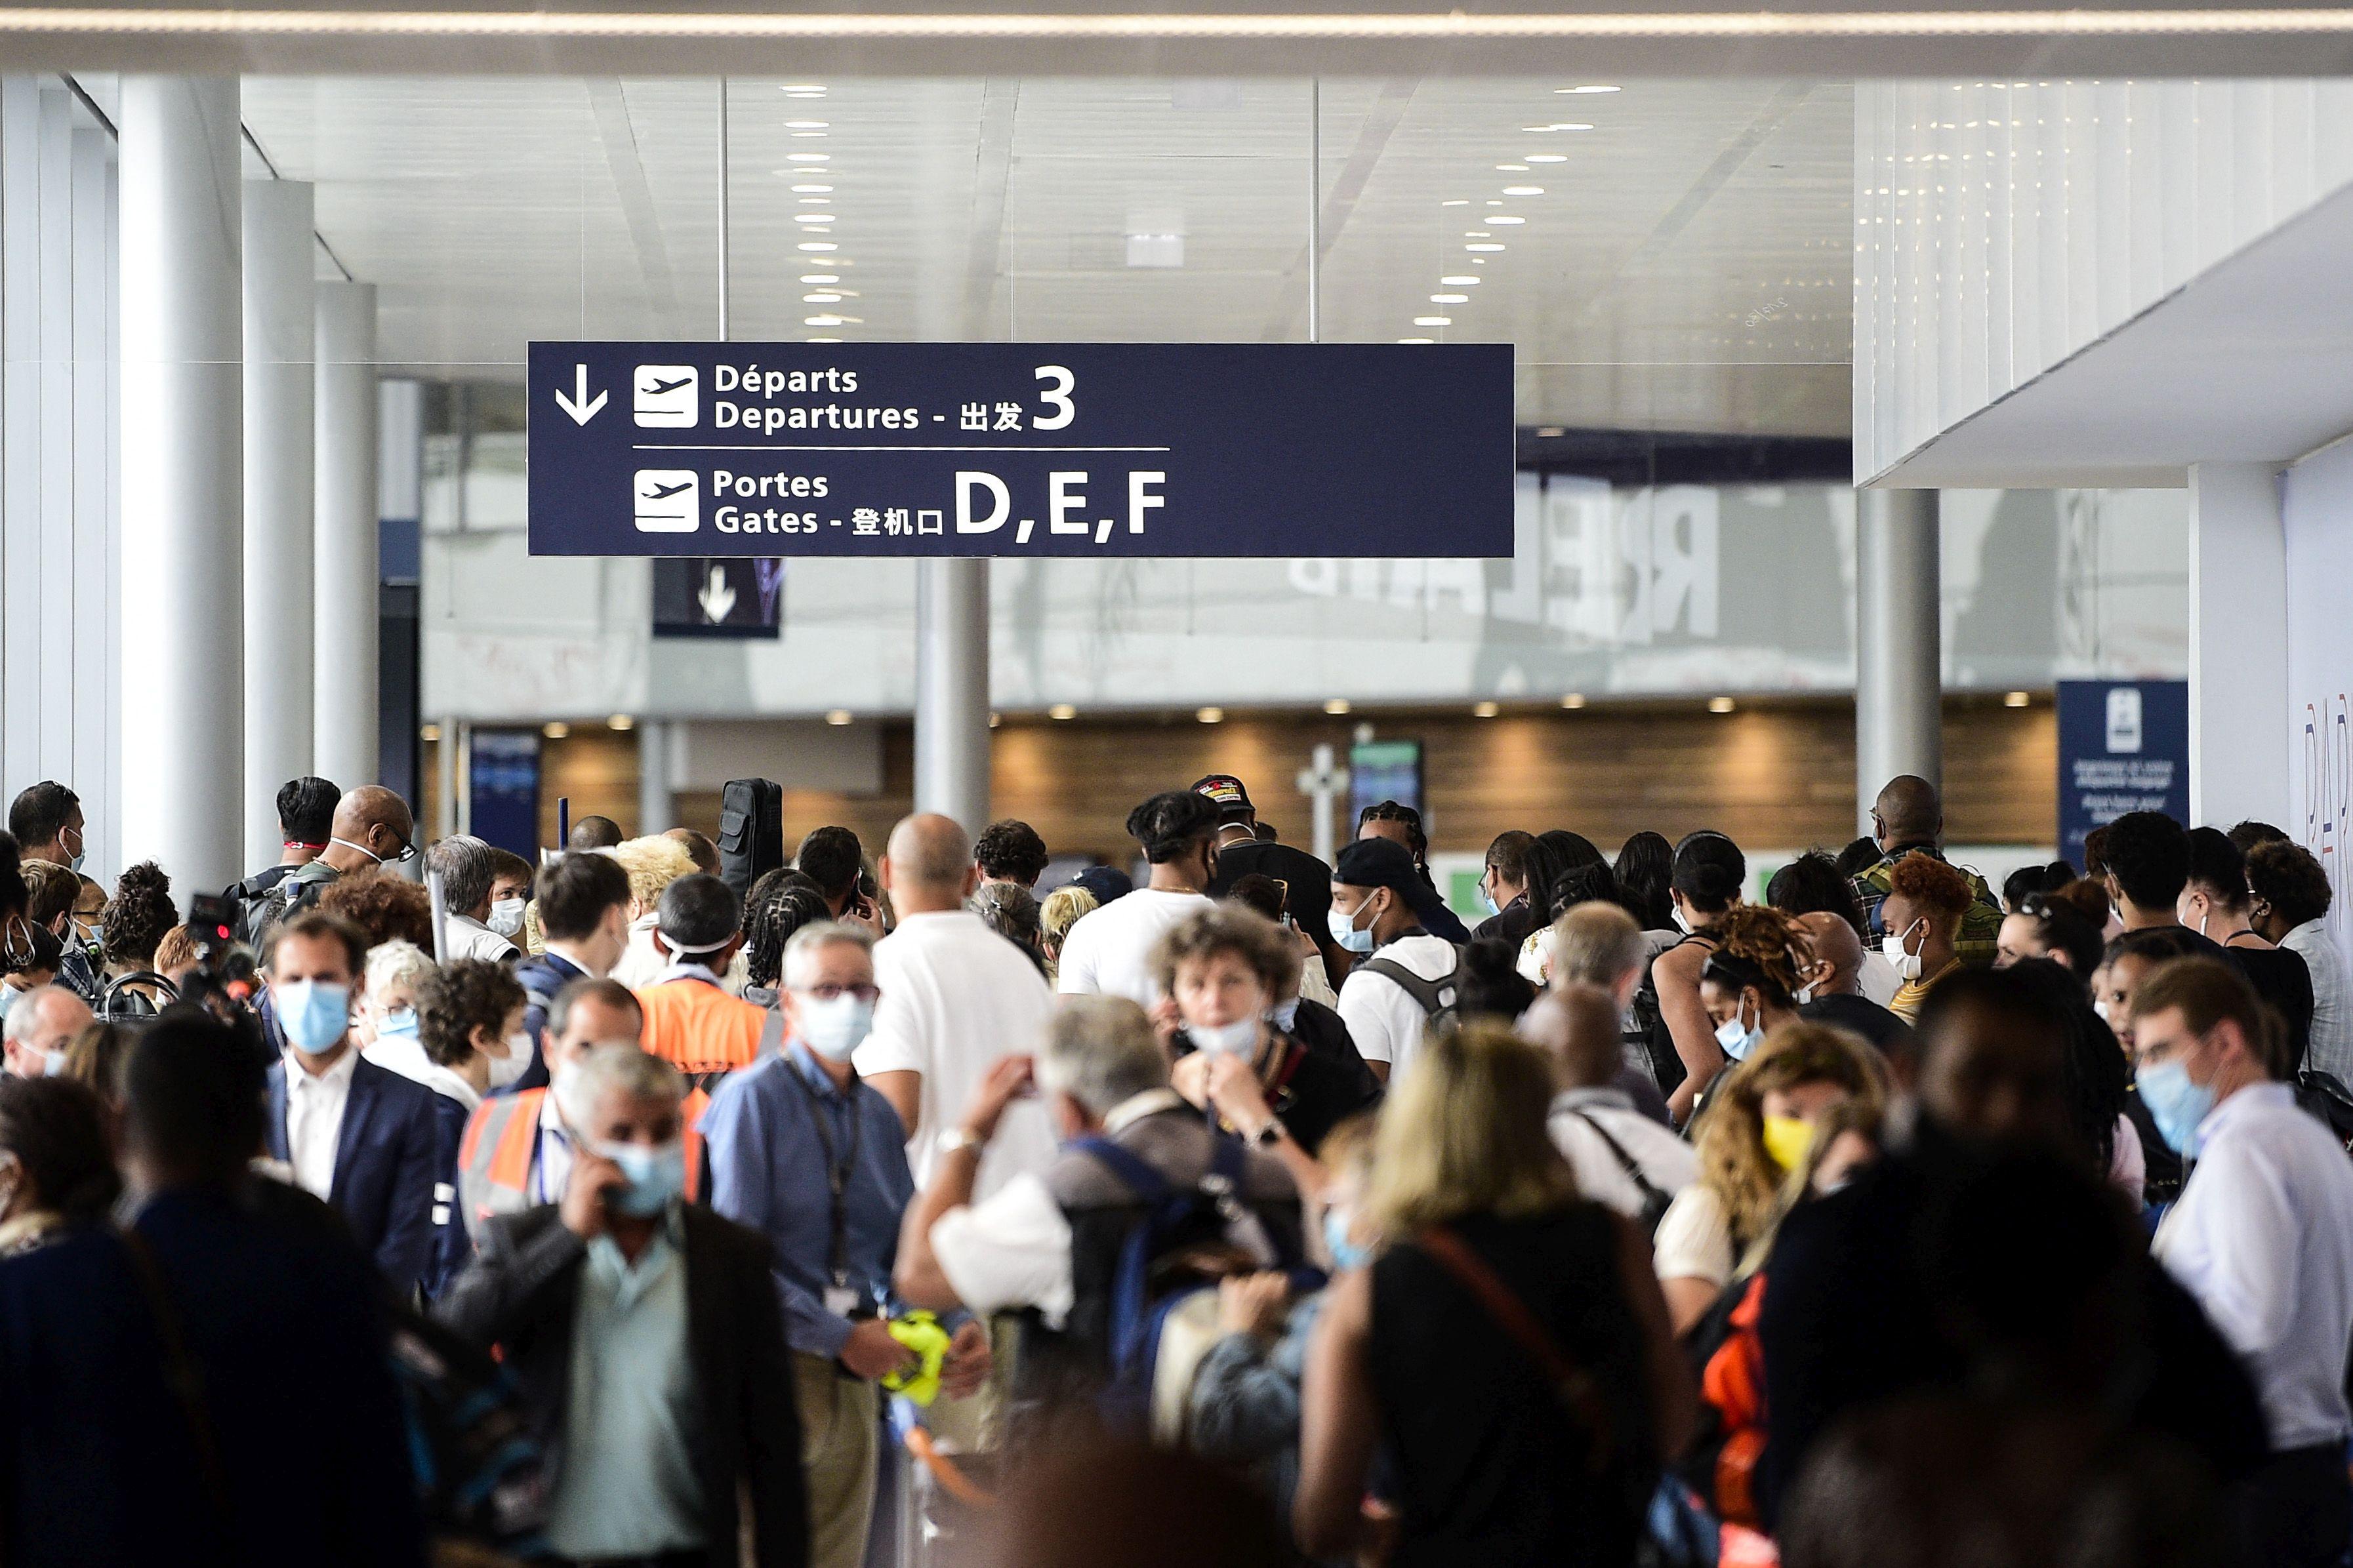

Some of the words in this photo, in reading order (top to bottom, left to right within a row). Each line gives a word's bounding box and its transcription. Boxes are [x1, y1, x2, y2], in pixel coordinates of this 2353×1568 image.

[714, 364, 858, 400] Départs
[714, 401, 920, 436] Departures
[960, 401, 1023, 432] 出发
[1032, 365, 1076, 431] 3
[713, 470, 829, 498] Portes
[714, 506, 819, 534] Gates
[851, 508, 943, 536] 登机口
[2305, 693, 2353, 932] PAR
